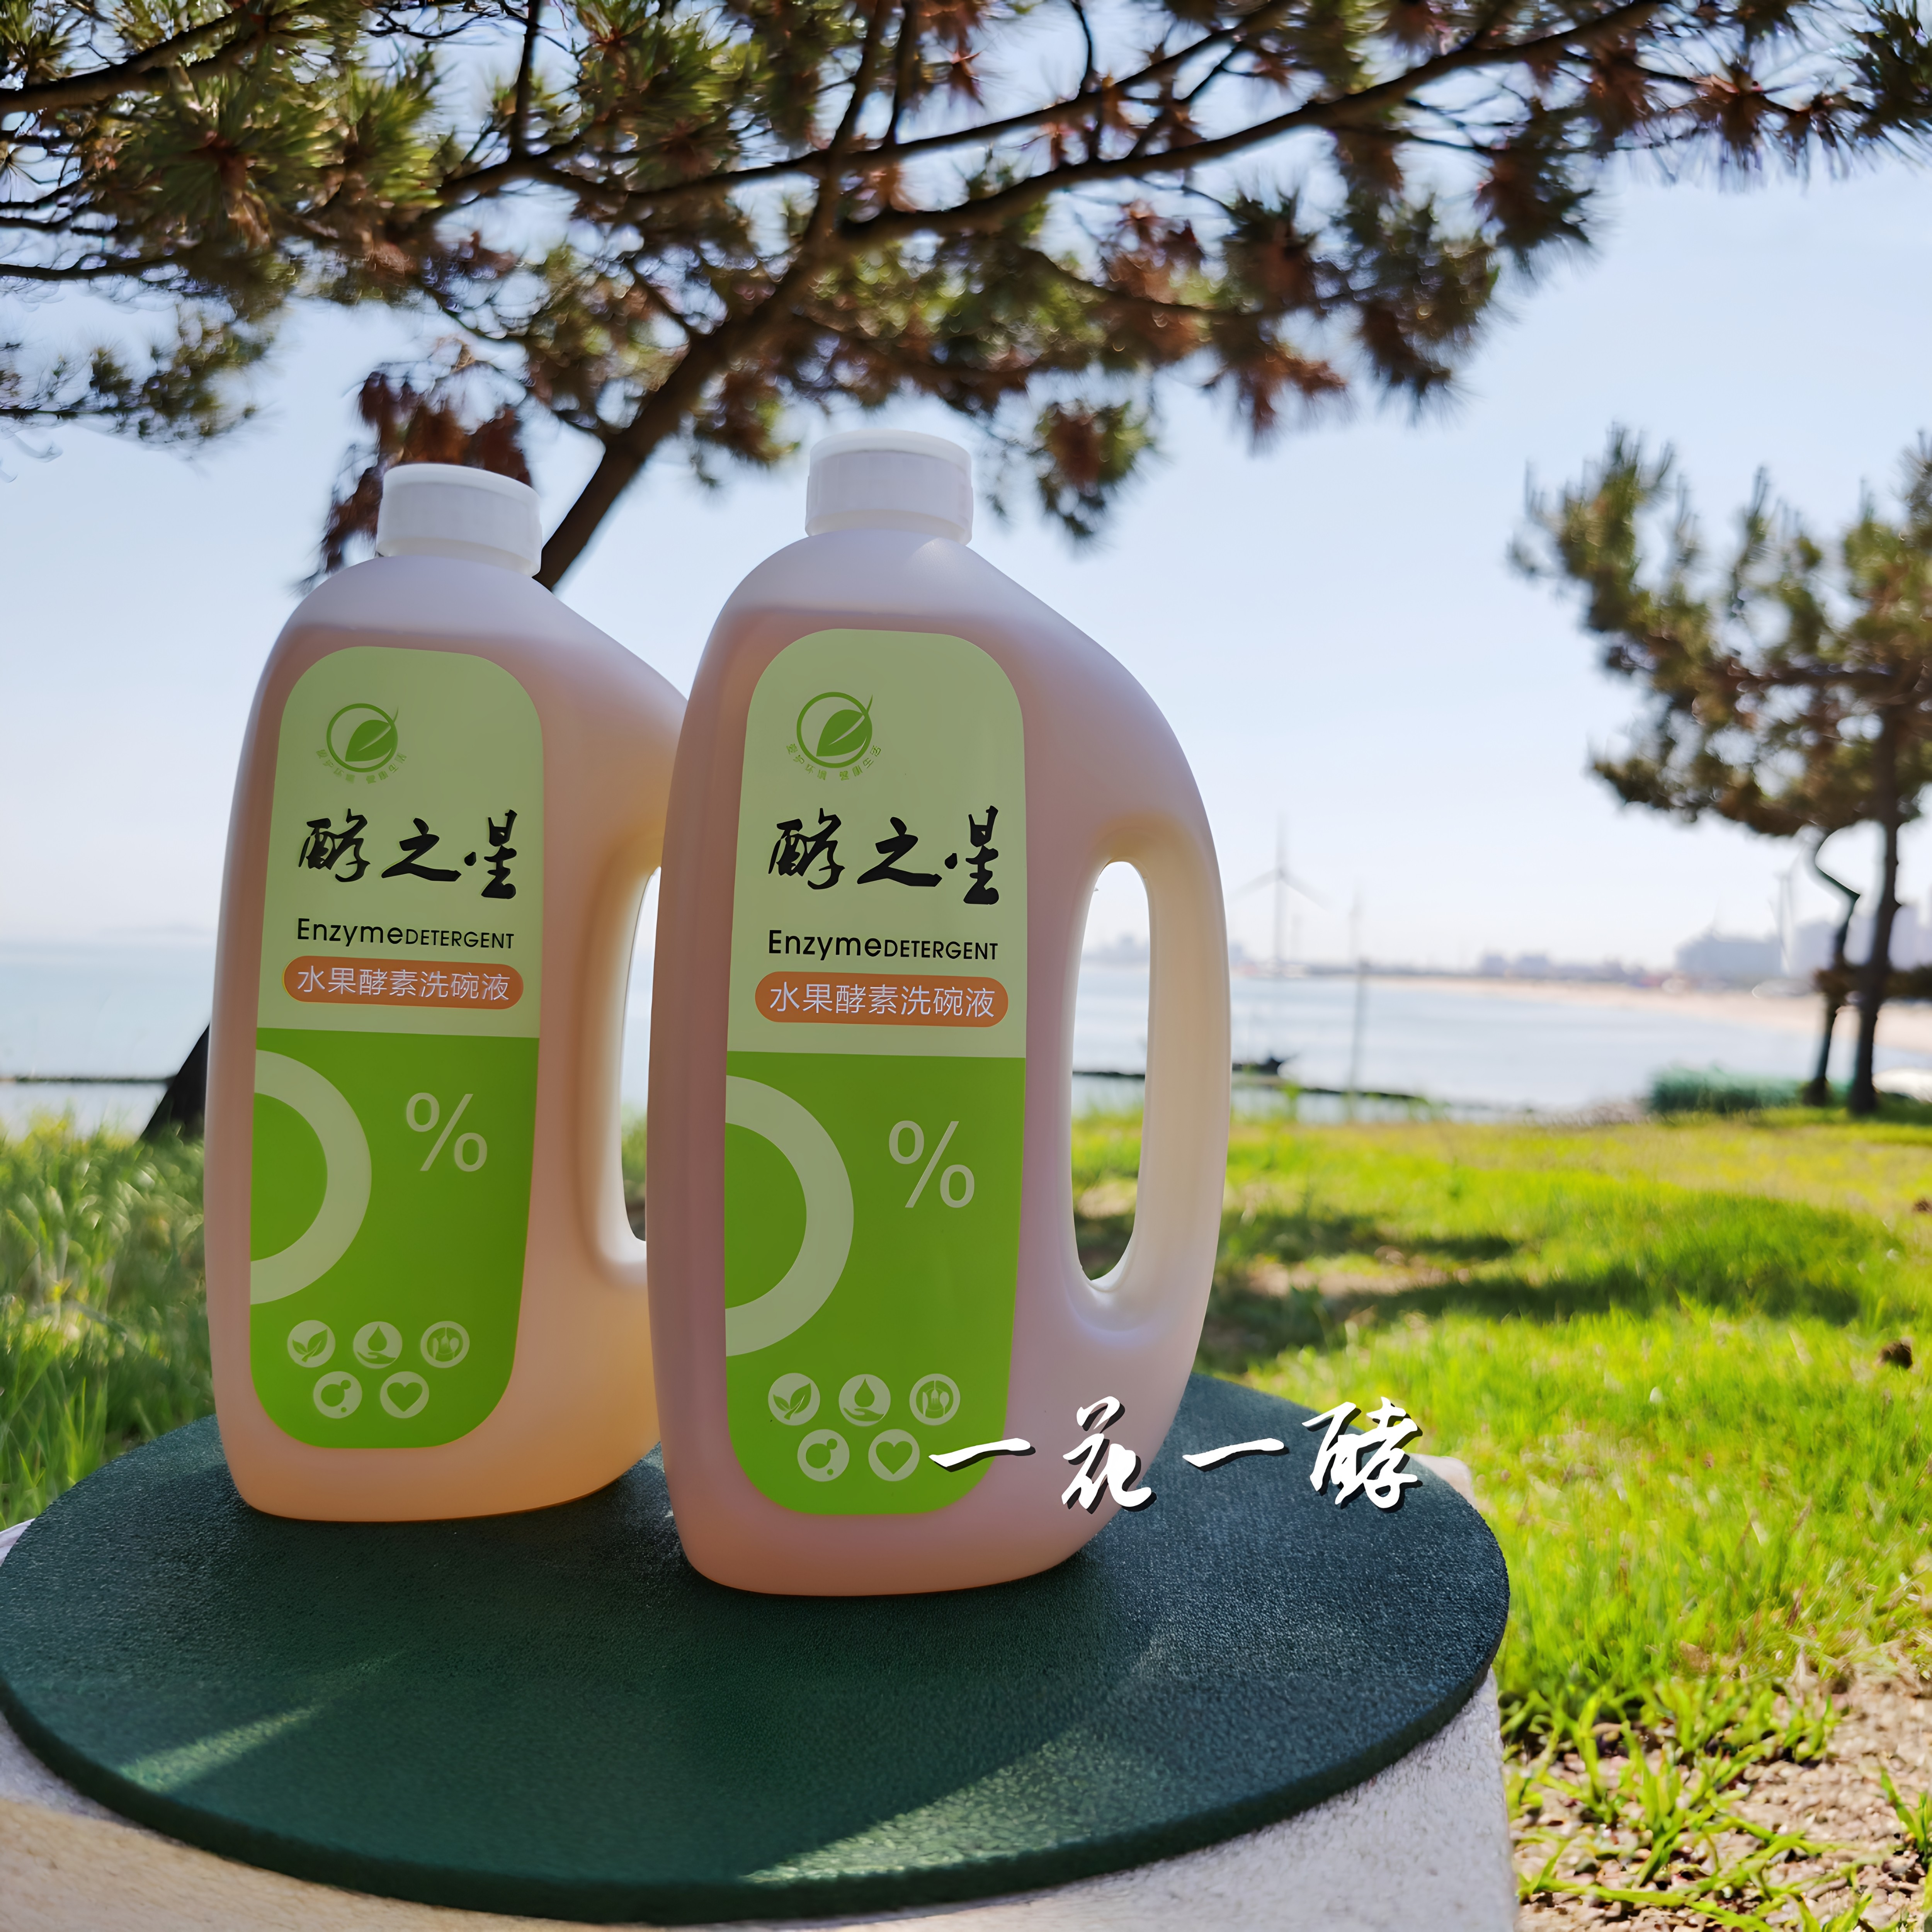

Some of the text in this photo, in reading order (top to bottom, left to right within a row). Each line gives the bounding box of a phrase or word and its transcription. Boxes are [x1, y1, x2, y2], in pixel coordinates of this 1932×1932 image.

[298, 808, 517, 900] 酵之星
[768, 805, 999, 905] 酵之星
[297, 965, 510, 1001] 水果酵素洗碗液
[770, 981, 996, 1018] 水果酵素洗碗液
